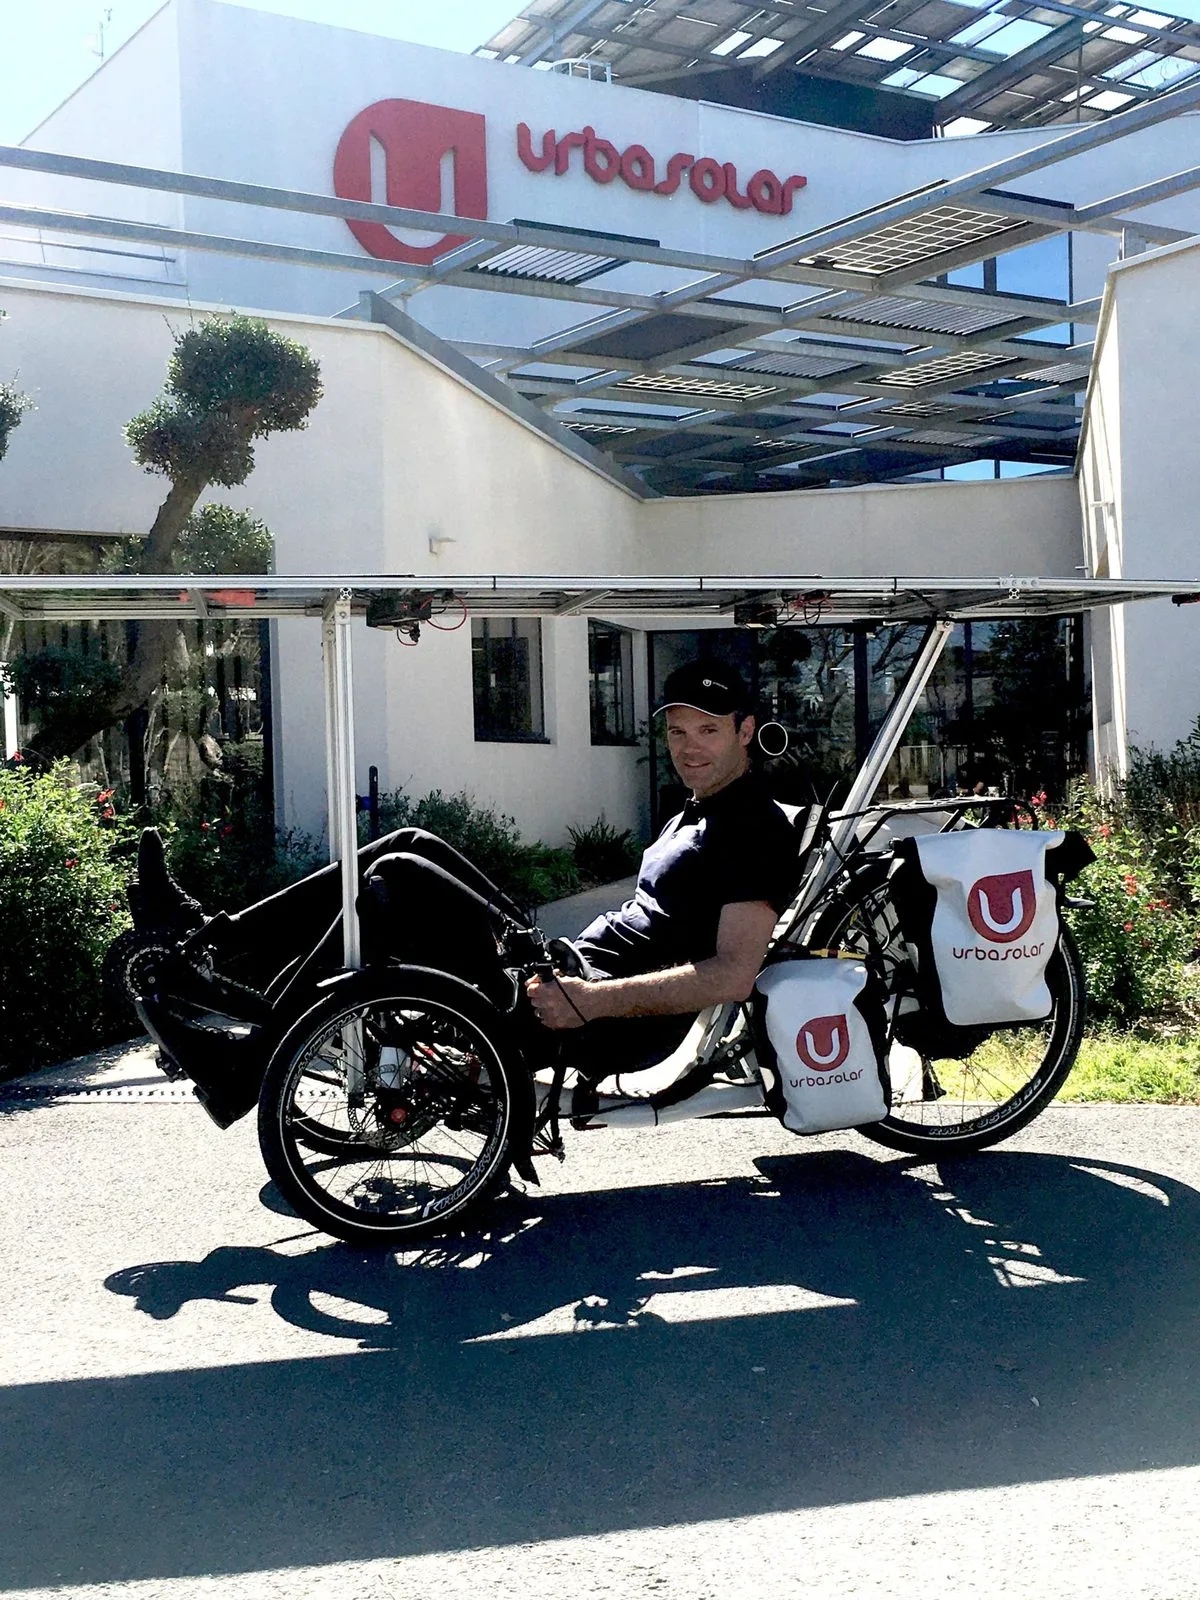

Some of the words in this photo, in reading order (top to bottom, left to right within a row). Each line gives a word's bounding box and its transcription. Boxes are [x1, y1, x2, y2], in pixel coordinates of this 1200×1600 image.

[517, 122, 807, 215] urbasolar
[952, 942, 1045, 961] urbasolar
[789, 1068, 864, 1088] urbasolar
